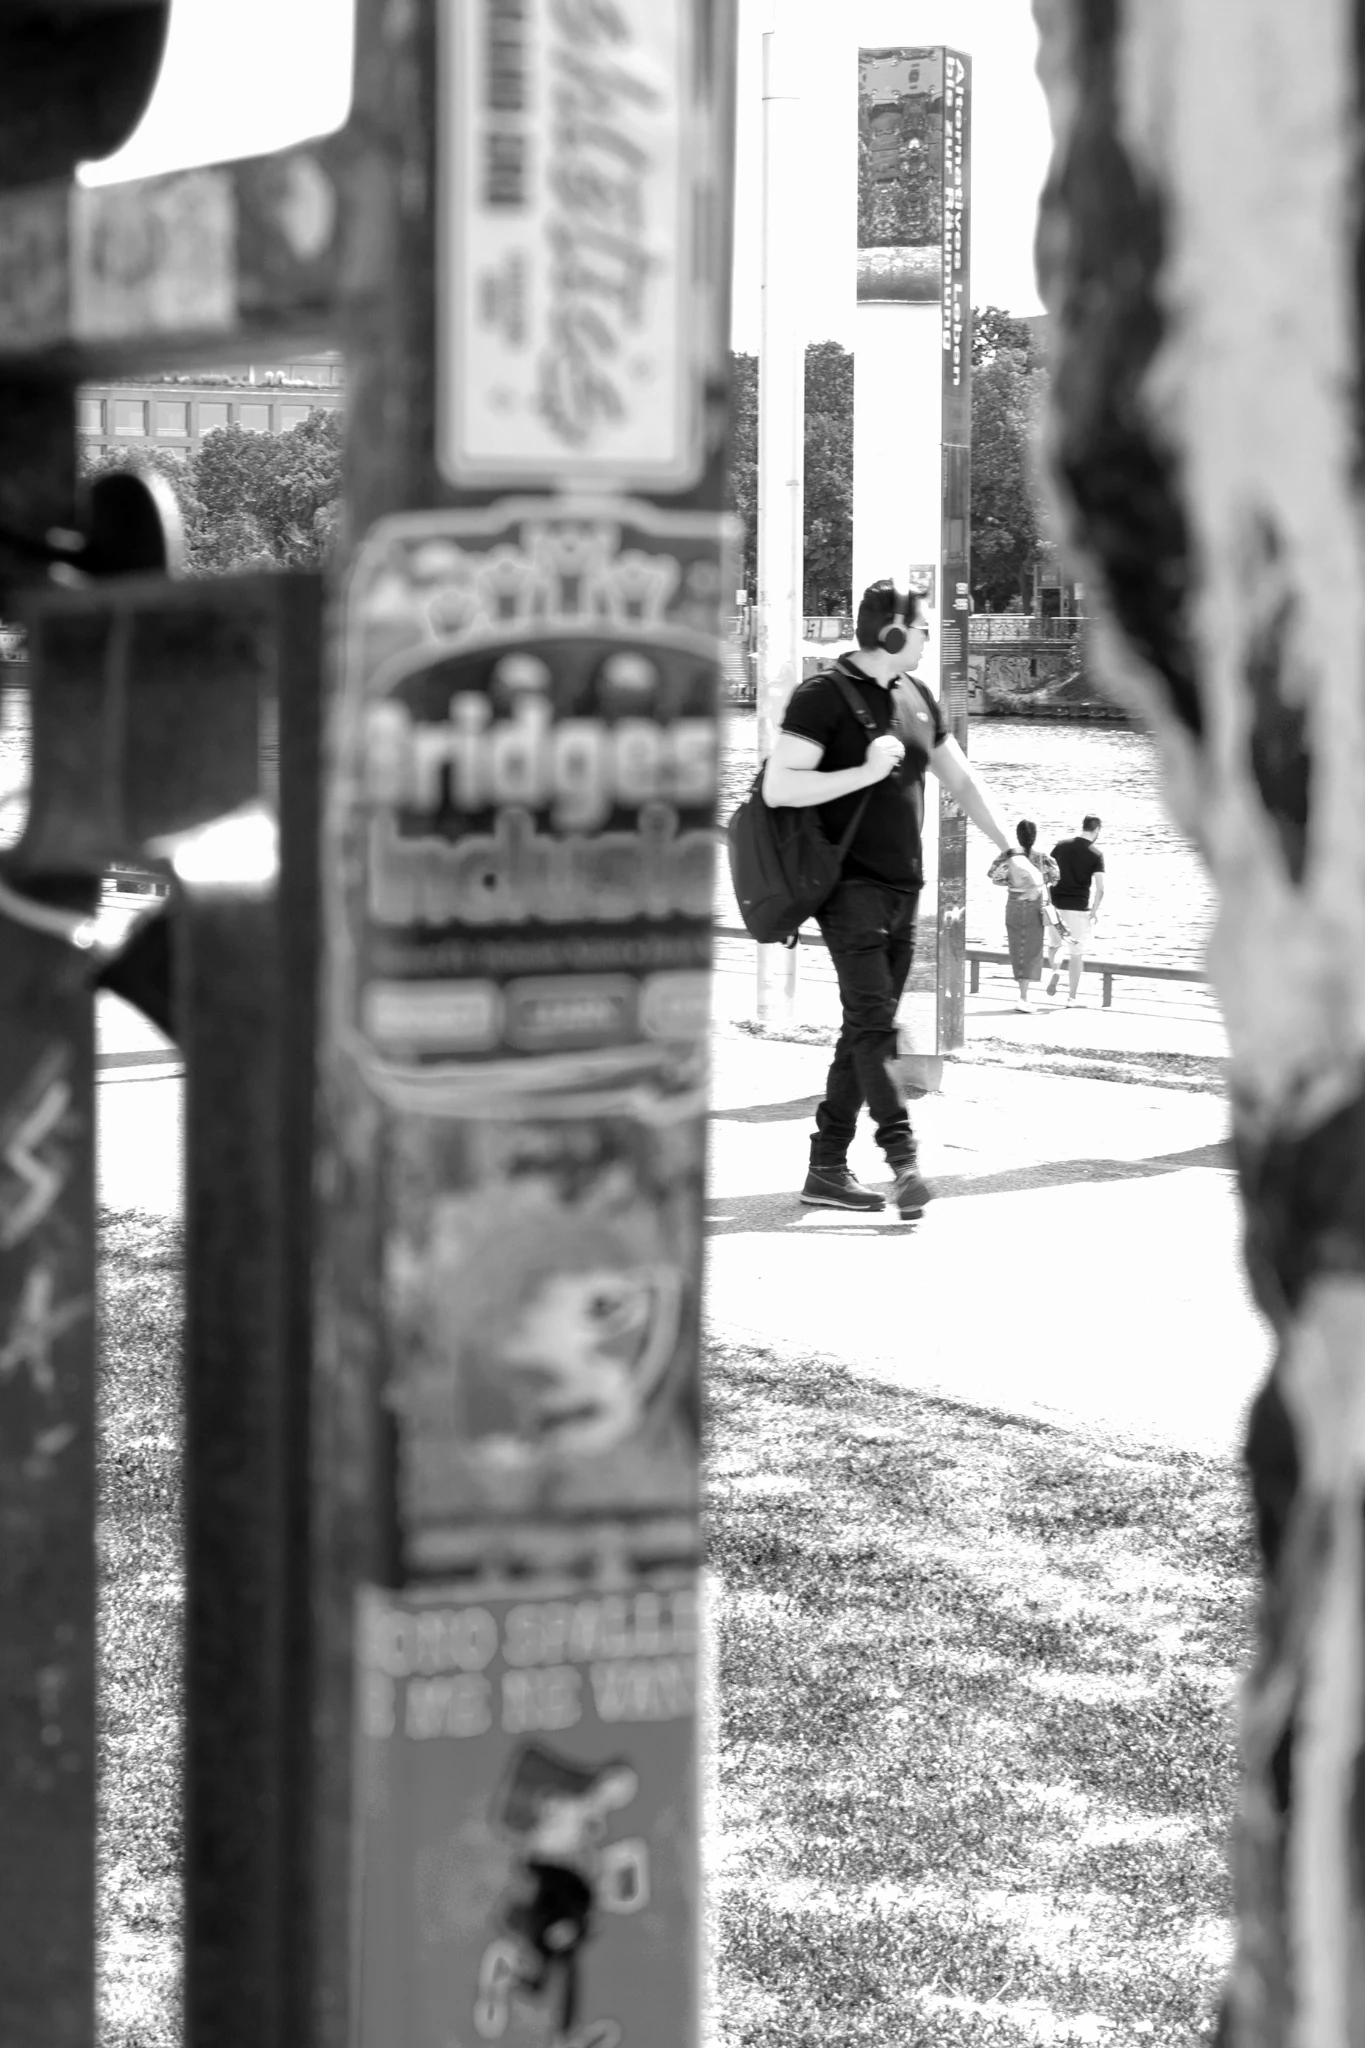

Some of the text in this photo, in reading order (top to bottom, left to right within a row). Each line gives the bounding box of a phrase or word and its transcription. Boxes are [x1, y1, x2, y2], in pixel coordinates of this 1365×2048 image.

[945, 56, 956, 107] bis
[944, 119, 953, 175] zur
[953, 283, 963, 386] Leben
